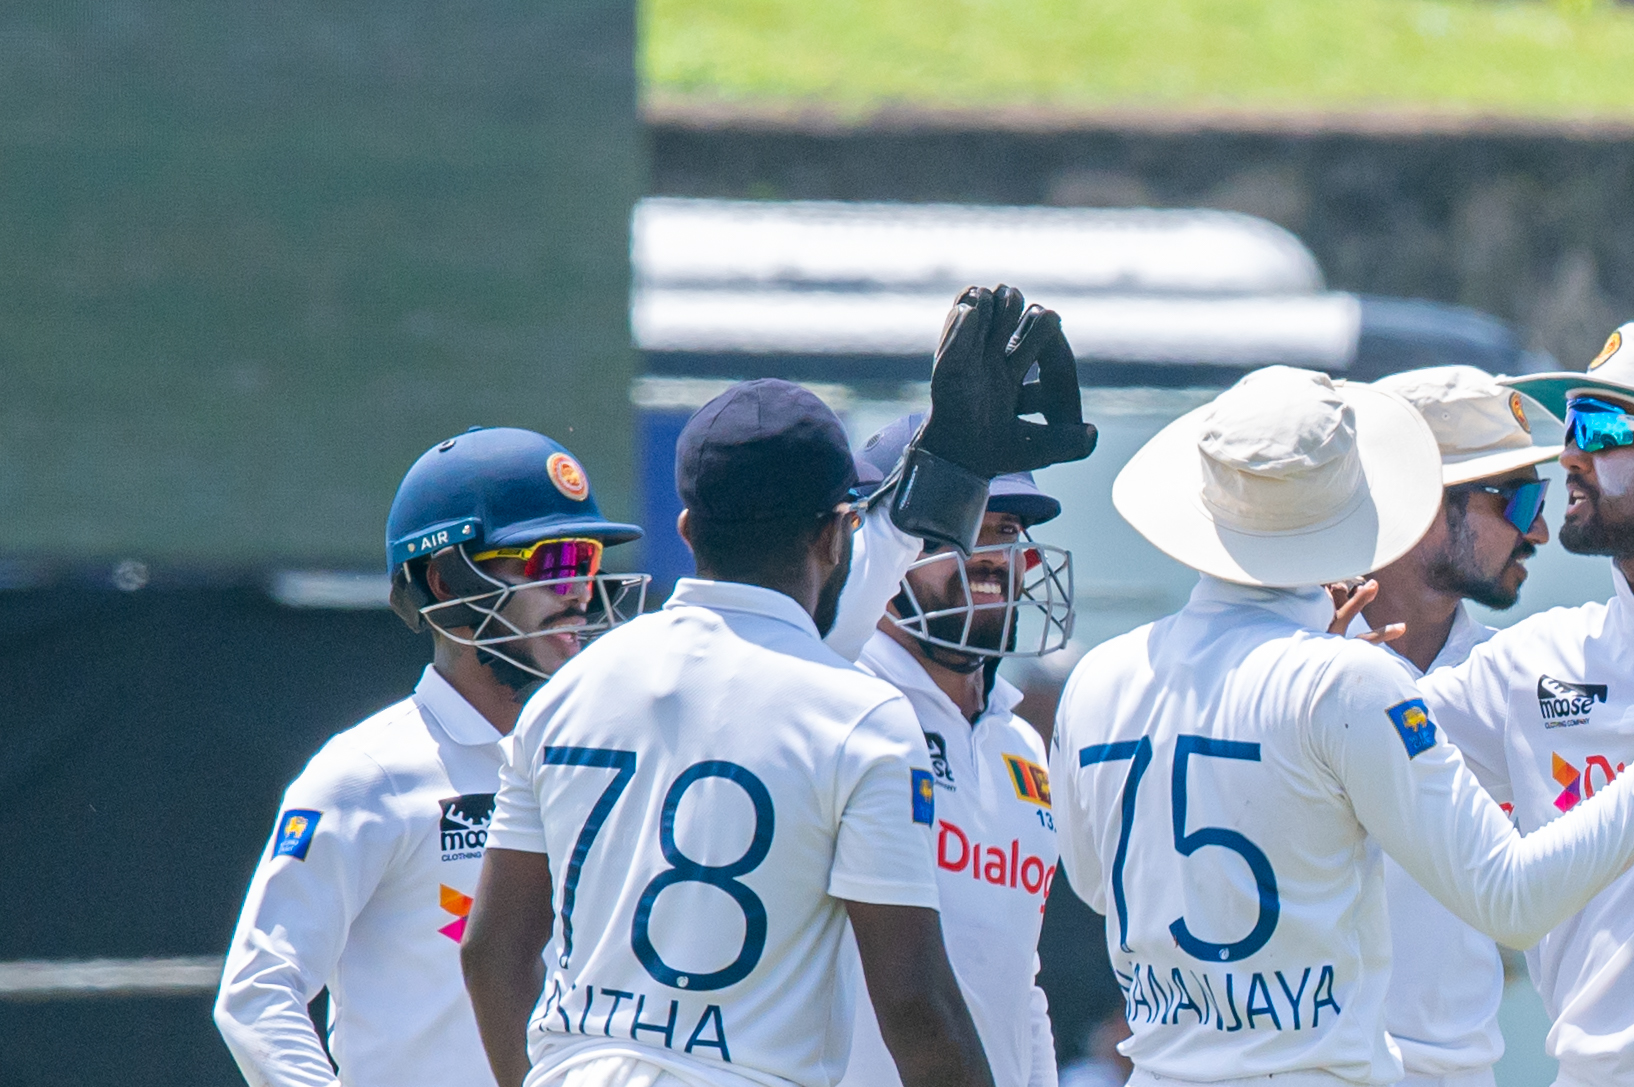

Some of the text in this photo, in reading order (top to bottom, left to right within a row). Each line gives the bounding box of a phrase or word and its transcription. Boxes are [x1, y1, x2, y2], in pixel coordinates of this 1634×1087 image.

[421, 531, 449, 551] AIR
[1540, 697, 1594, 719] moose
[1036, 808, 1057, 833] 13
[441, 851, 483, 862] CLOTHING
[1079, 734, 1281, 963] 75
[542, 746, 776, 991] 78
